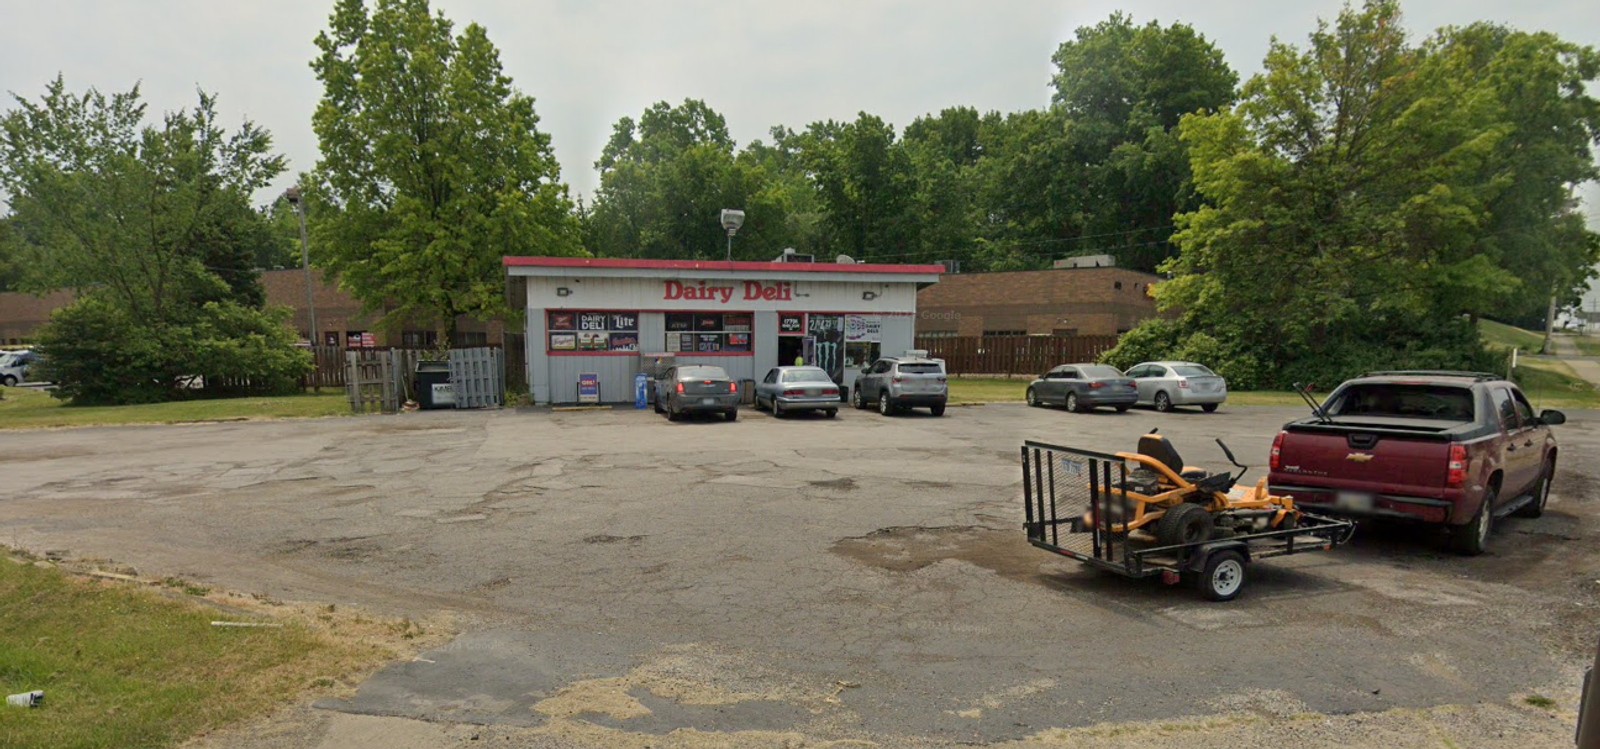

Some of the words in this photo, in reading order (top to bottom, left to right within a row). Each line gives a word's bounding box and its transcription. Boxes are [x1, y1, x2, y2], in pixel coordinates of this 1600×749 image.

[663, 281, 734, 304] Dairy
[743, 281, 792, 301] Deli
[581, 314, 605, 322] DAIRY
[613, 314, 635, 329] Lite
[581, 321, 605, 330] DELI
